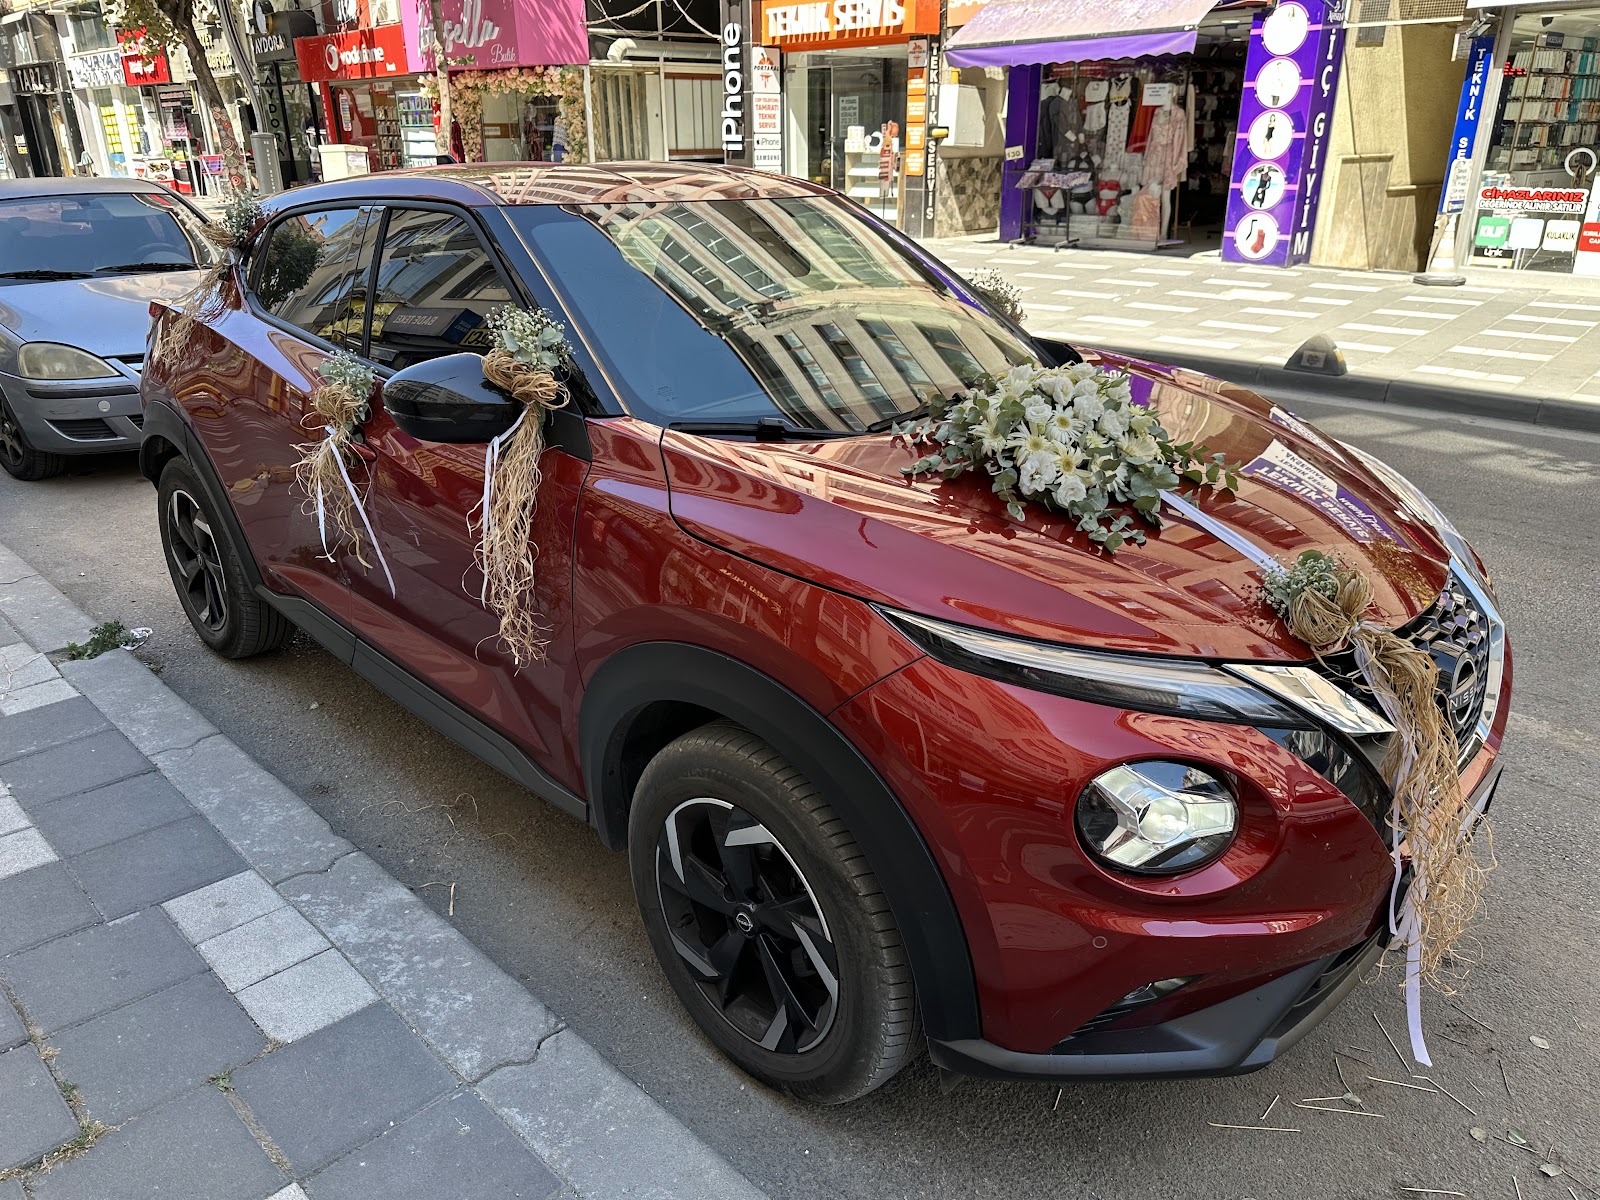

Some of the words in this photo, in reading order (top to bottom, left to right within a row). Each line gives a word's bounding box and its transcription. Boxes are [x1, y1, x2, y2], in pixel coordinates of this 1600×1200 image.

[255, 34, 285, 54] AYDORA
[490, 43, 516, 63] Butik
[721, 22, 743, 151] iPhone
[1481, 187, 1584, 202] CİHAZLARINIZ
[1546, 231, 1575, 240] KULAKLIK
[1449, 686, 1475, 710] NISS
